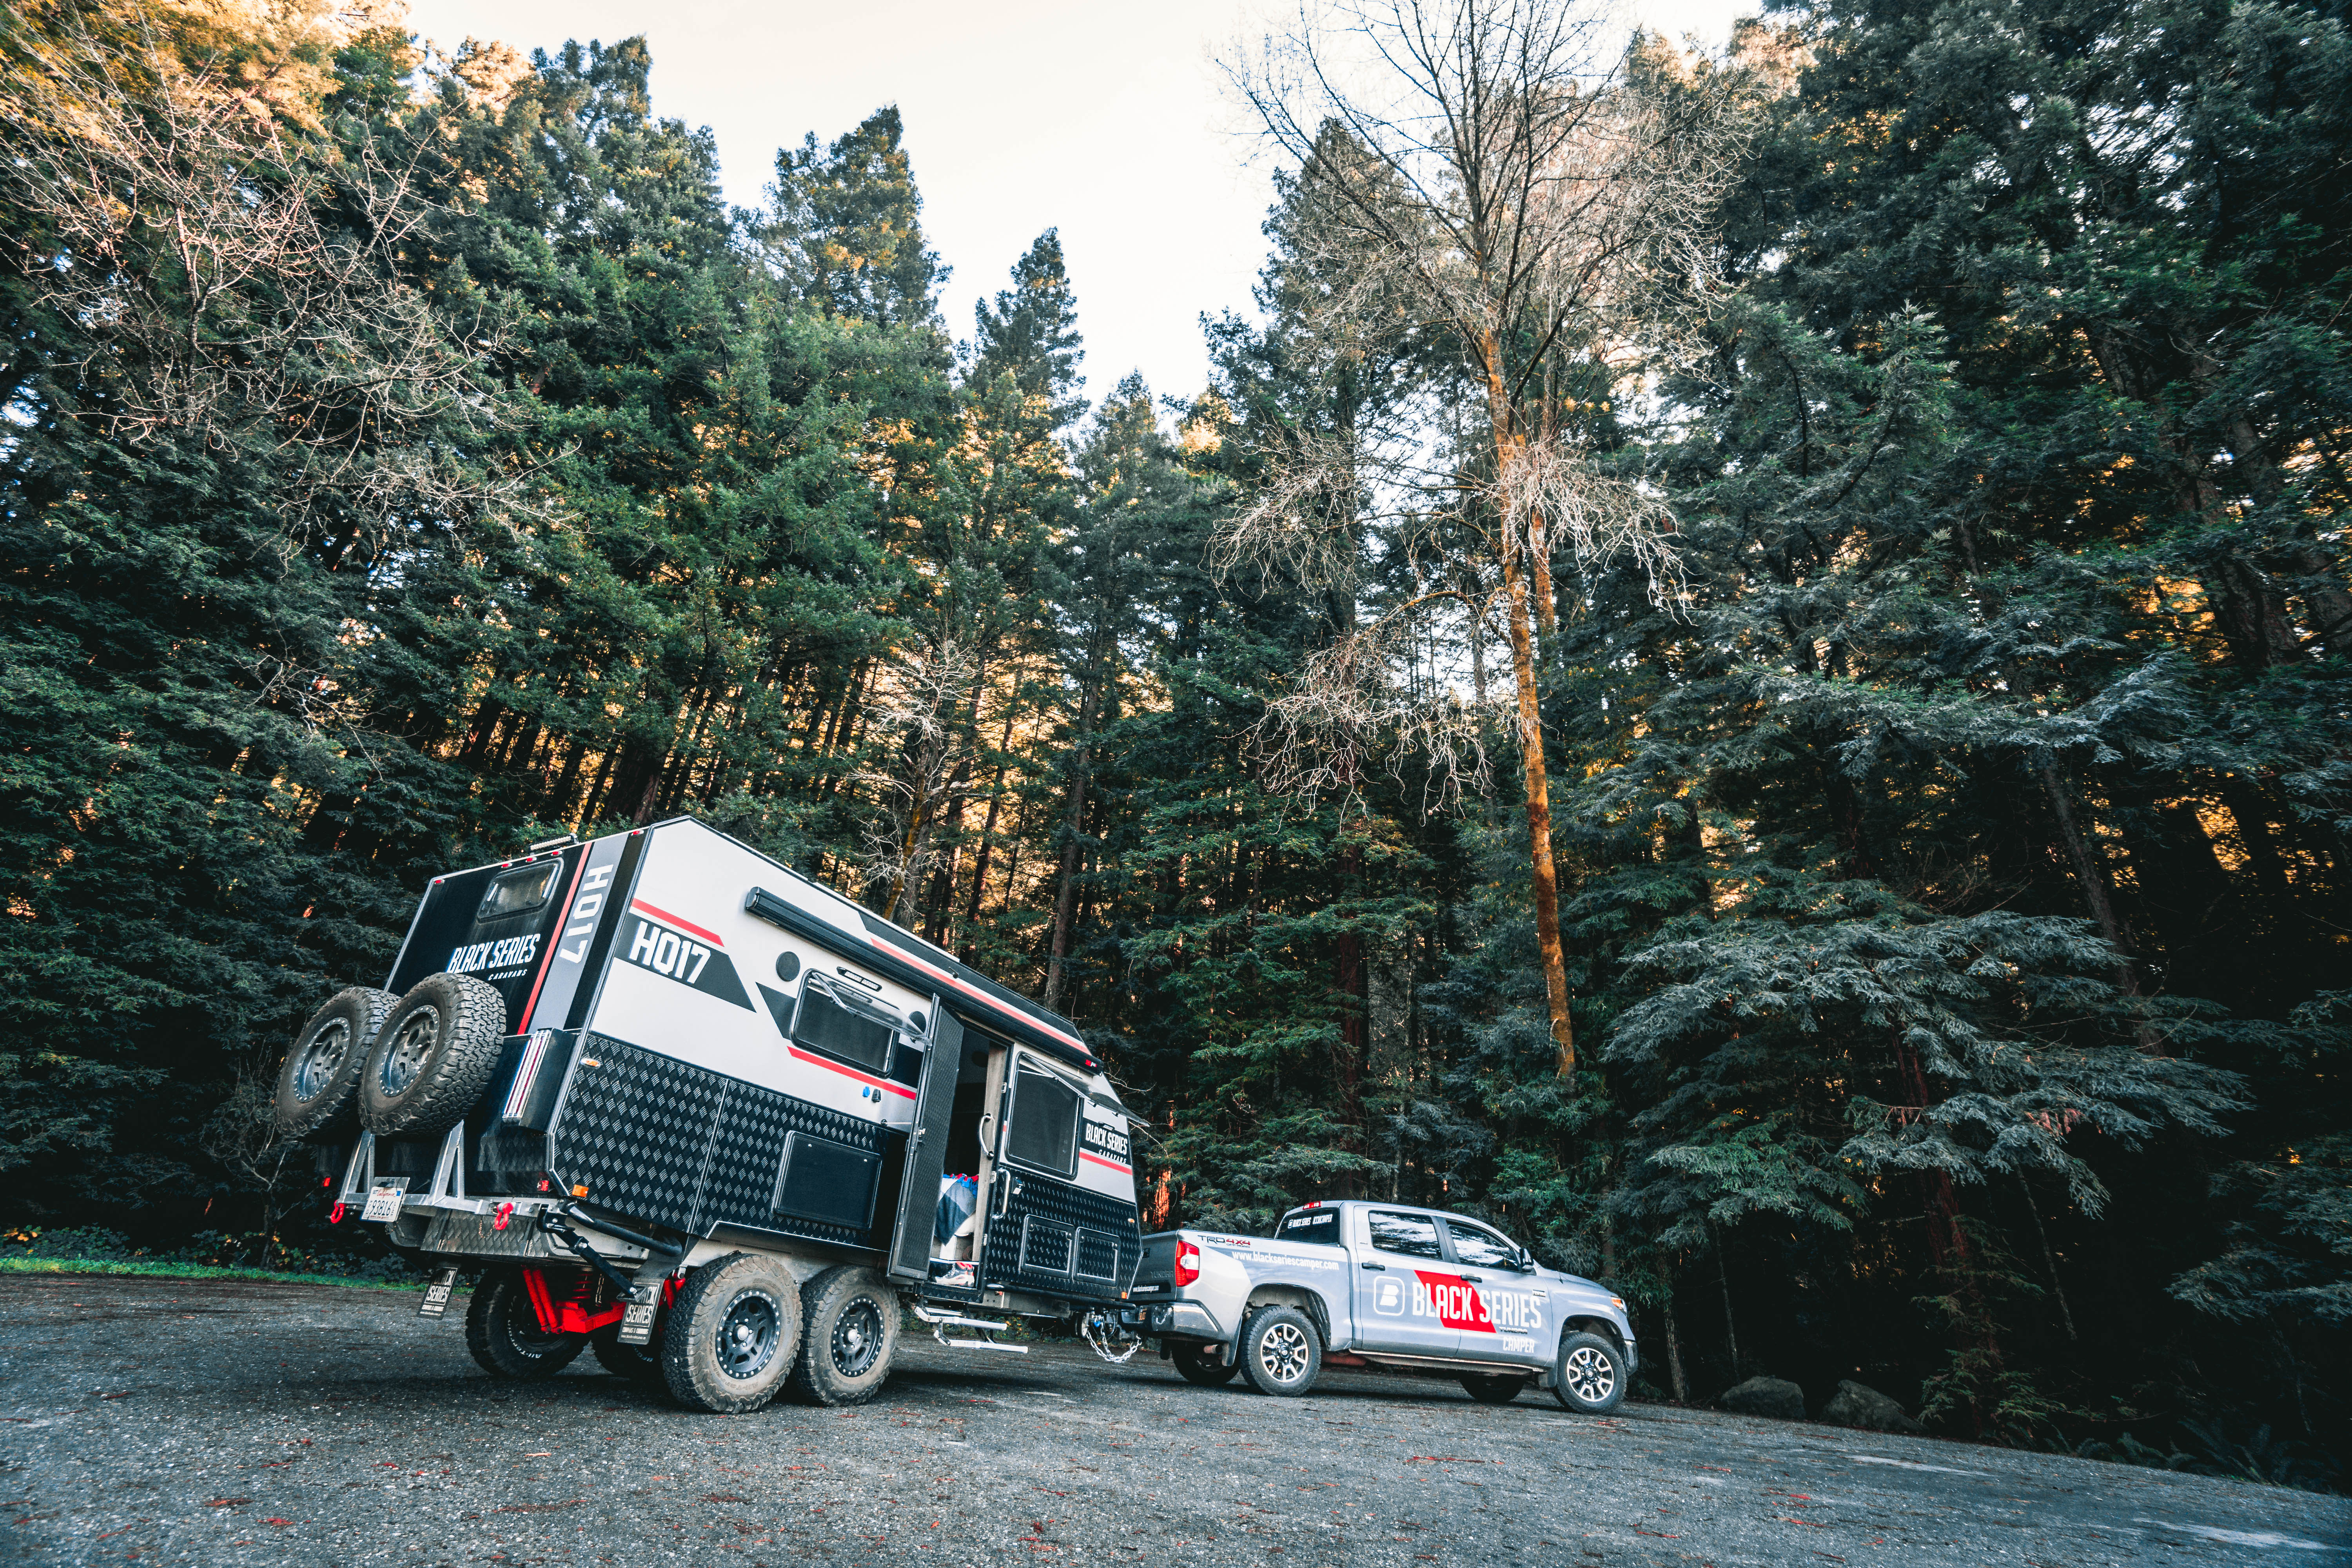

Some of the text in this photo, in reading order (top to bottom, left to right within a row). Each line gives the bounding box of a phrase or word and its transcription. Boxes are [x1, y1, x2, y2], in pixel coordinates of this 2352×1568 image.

[446, 933, 541, 974] BLACK SERIES
[488, 969, 528, 980] CARAVANS
[1085, 1123, 1128, 1155] BLACK SERIES
[1099, 1149, 1127, 1164] CARAVANS
[369, 1200, 394, 1216] 93816
[1198, 1235, 1226, 1244] TRD
[1232, 1251, 1339, 1270] www.blackseriescamper.com
[426, 1285, 450, 1303] SERIES
[1412, 1282, 1541, 1328] BLACK SERIES
[626, 1305, 653, 1324] SERIES
[1503, 1336, 1534, 1353] CAMPER
